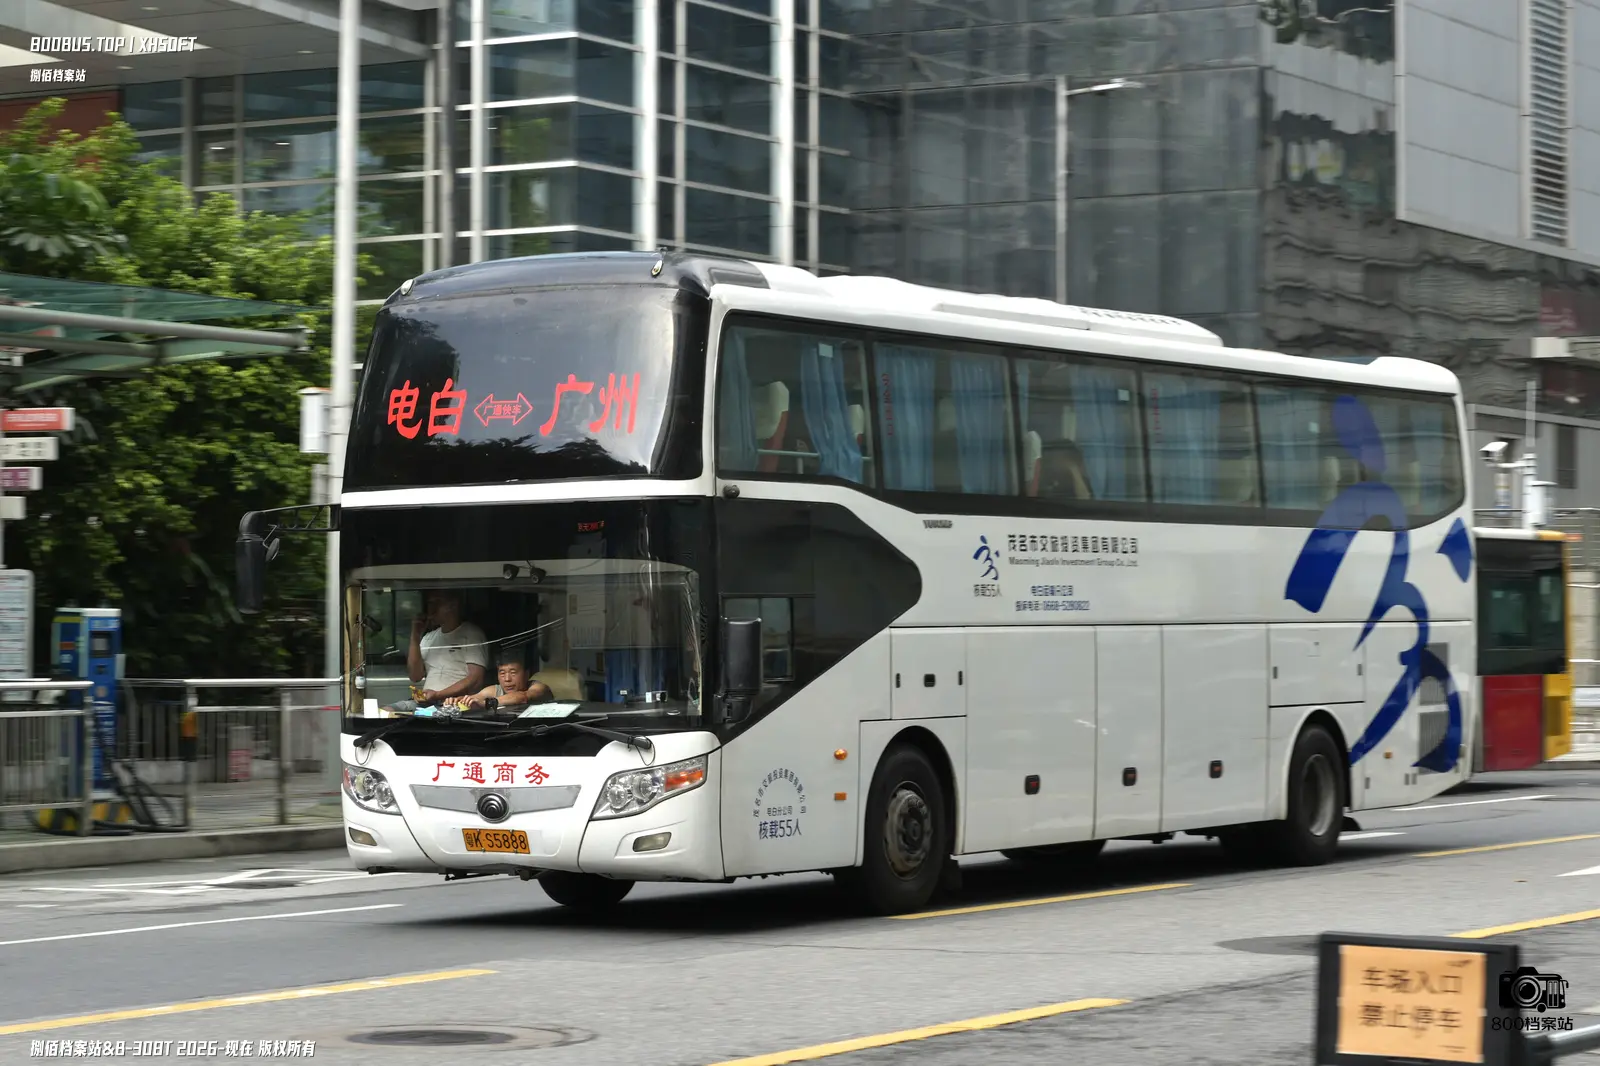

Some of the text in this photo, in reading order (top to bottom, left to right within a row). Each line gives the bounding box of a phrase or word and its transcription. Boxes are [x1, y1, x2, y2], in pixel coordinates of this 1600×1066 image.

[387, 372, 641, 439] 电白 广州
[432, 760, 550, 785] 广通商务
[759, 818, 802, 840] 核载55人
[1360, 967, 1463, 994] 车场入口
[1358, 1001, 1463, 1037] 禁止停车
